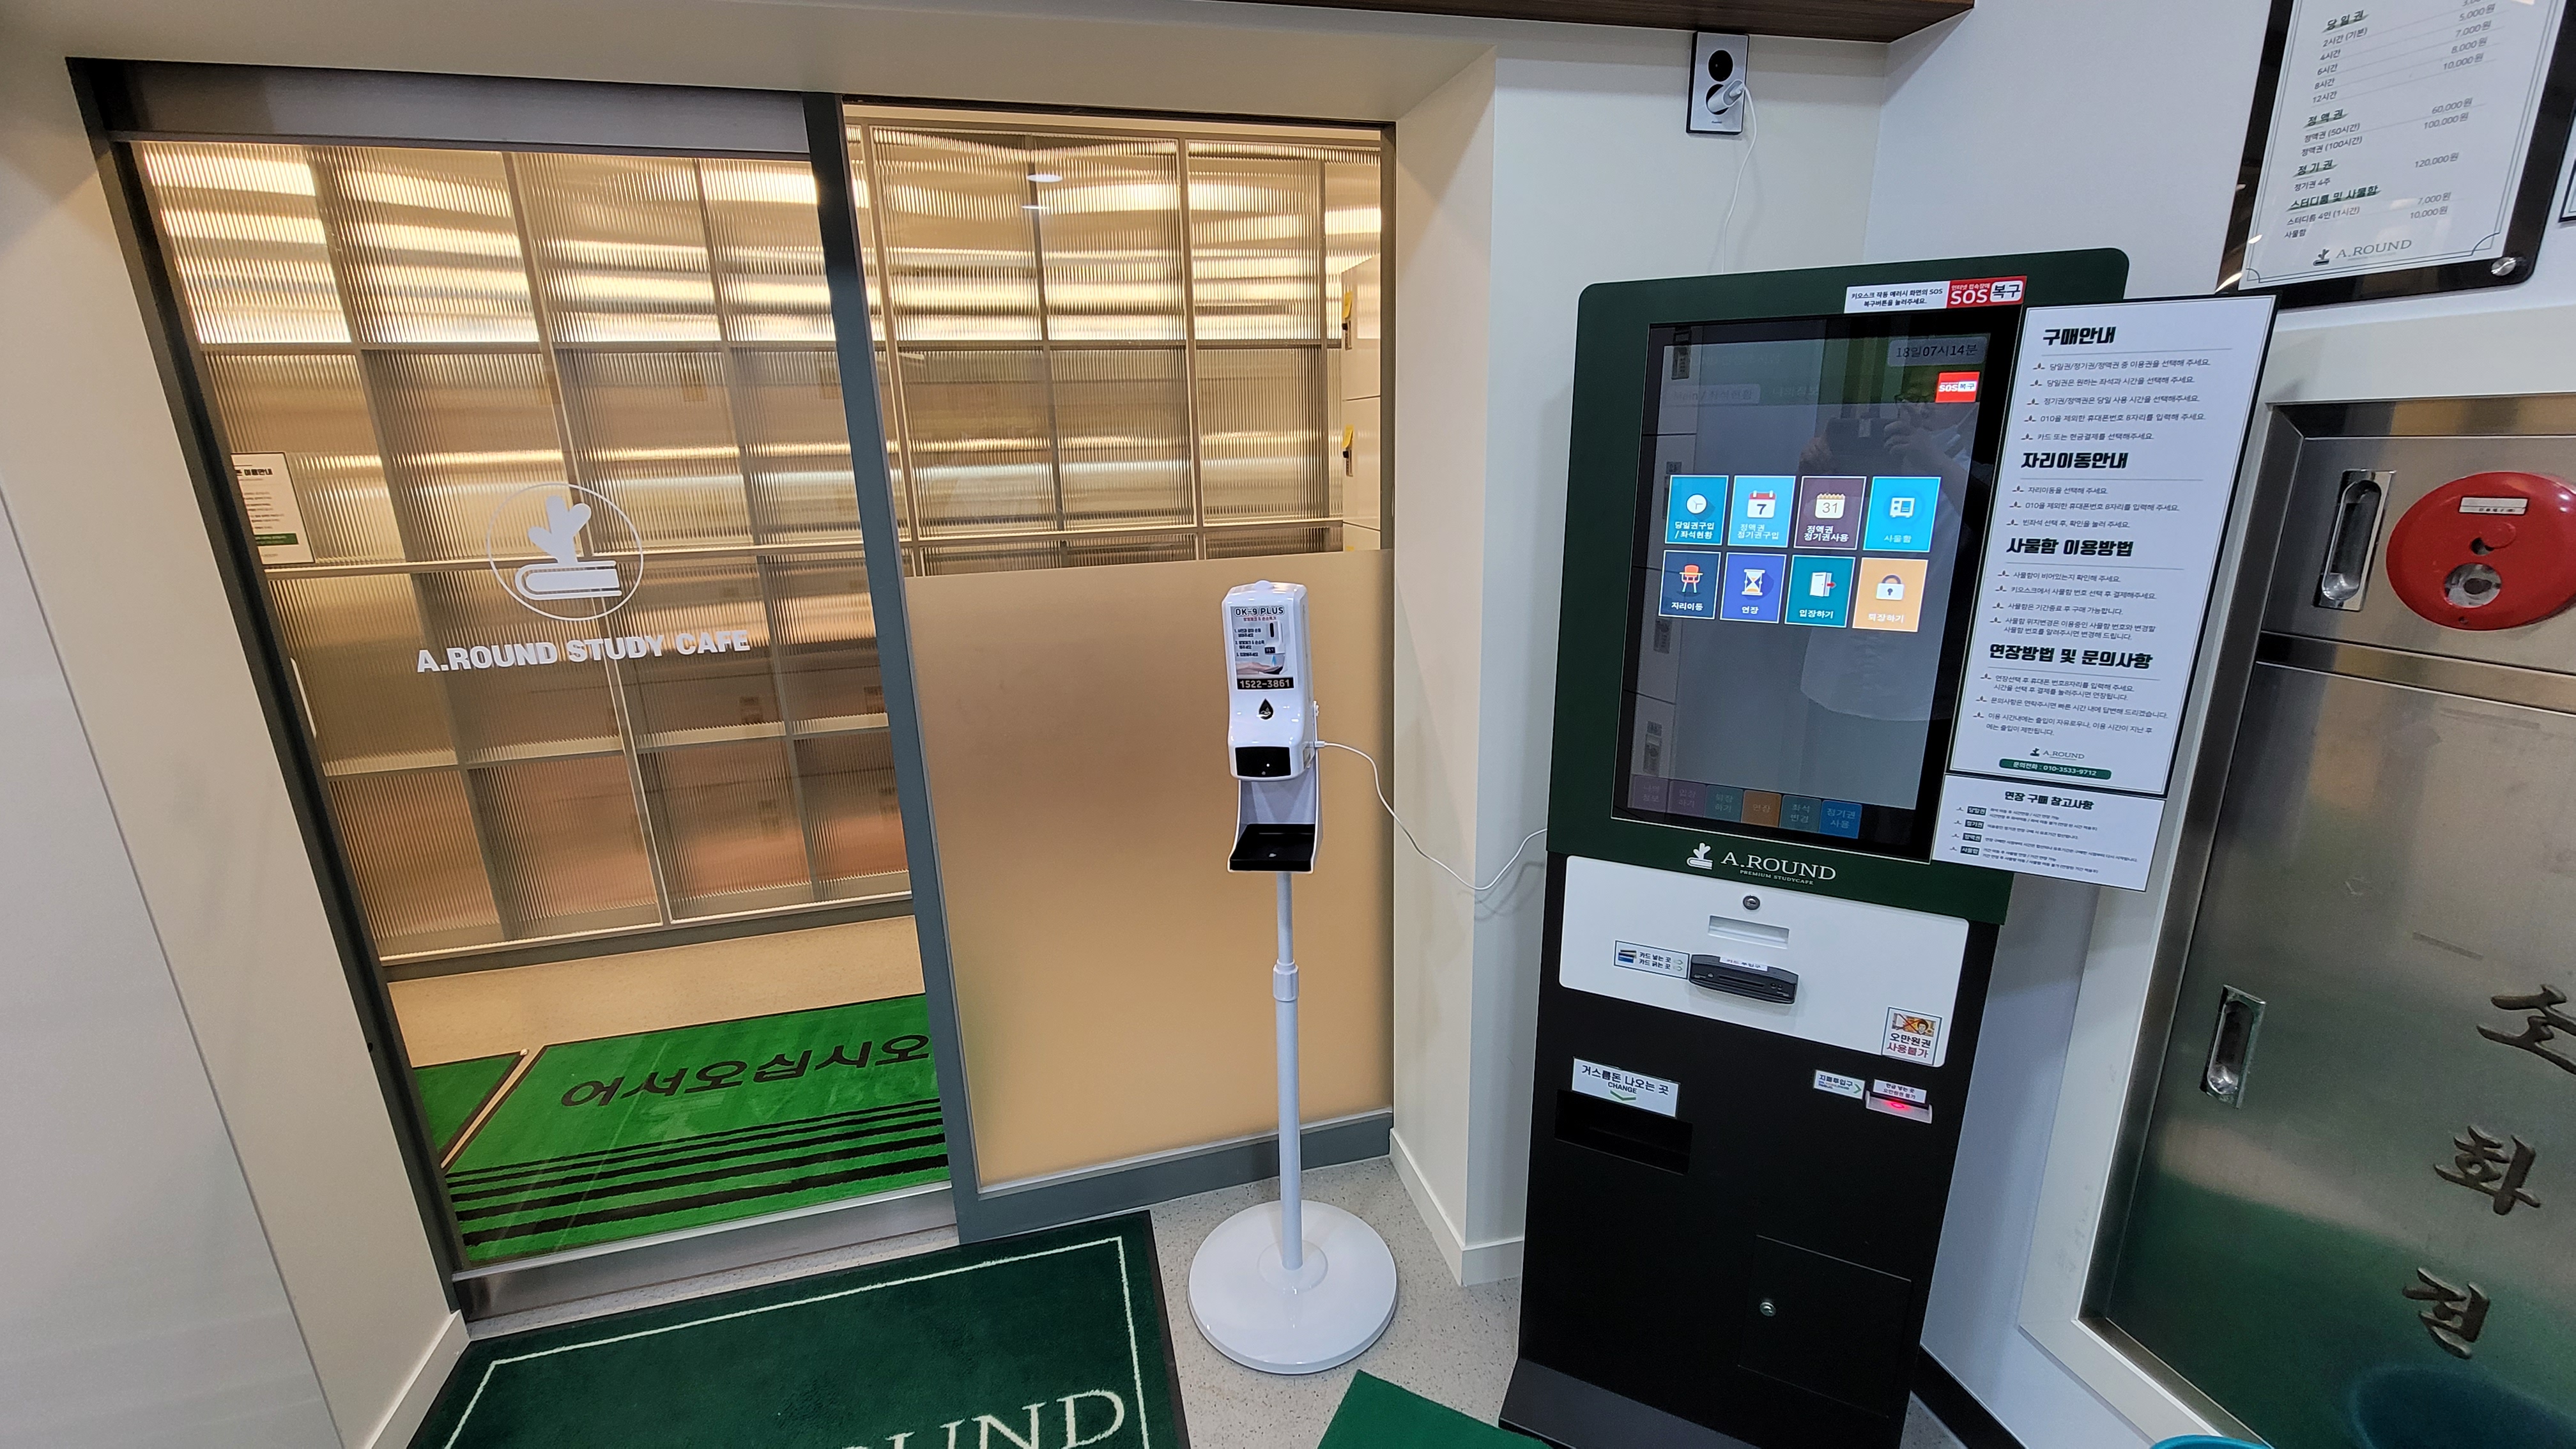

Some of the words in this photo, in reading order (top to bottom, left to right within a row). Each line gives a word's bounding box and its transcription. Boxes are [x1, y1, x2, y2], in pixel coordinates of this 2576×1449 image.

[2322, 34, 2343, 47] 2시간
[2345, 27, 2368, 41] (기본)
[2320, 49, 2341, 60] 4시간
[2444, 53, 2484, 70] 10,000원
[2317, 63, 2338, 75] 6시간
[2314, 78, 2335, 89] 8시간
[2313, 91, 2337, 103] 12시간
[2432, 97, 2472, 114] 60,000원
[2424, 112, 2469, 129] 100,000원
[2304, 130, 2326, 143] 정액권
[2328, 123, 2360, 137] (50시간)
[2325, 136, 2363, 151] (100시간)
[2414, 152, 2460, 168] 120,000원
[2294, 180, 2316, 192] 정기권
[2333, 192, 2343, 202] 및
[2346, 185, 2379, 199] 사물함
[2418, 192, 2451, 205] 7,000원
[2318, 211, 2331, 220] 4인
[2333, 206, 2360, 218] (1시간)
[2411, 206, 2448, 218] 10,000원
[2284, 229, 2306, 239] 사물함
[2336, 240, 2412, 259] A.ROUND
[1951, 289, 1988, 305] SOS
[1992, 284, 2021, 298] 복구
[2043, 326, 2117, 346] 구매안내
[2162, 359, 2184, 367] 선택해
[1938, 383, 1959, 392] SOS
[2047, 379, 2074, 387] 당일권은
[2123, 377, 2144, 385] 시간을
[2021, 452, 2129, 469] 자리이동안내
[1756, 503, 1767, 516] 7
[1822, 502, 1839, 514] 31
[1675, 521, 1715, 531] 당일권구입
[1740, 523, 1765, 532] 정액권
[1807, 525, 1834, 534] 정액권
[1737, 530, 1779, 540] 정기권구입
[1804, 532, 1849, 542] 정기권사용
[1884, 534, 1912, 543] 사물함
[2006, 538, 2059, 555] 사물함
[2063, 539, 2134, 556] 이용방법
[1235, 608, 1258, 616] OK-9
[1261, 606, 1284, 615] PLUS
[1671, 602, 1703, 611] 자리이동
[1741, 605, 1759, 615] 연장
[1799, 609, 1834, 619] 입장하기
[1867, 613, 1905, 624] 퇴장하기
[417, 641, 558, 673] A.ROUND
[567, 635, 664, 663] STUDY
[675, 629, 750, 656] CAFE
[1989, 643, 2055, 663] 연장방법
[2060, 648, 2077, 664] 및
[2082, 650, 2154, 670] 문의사항
[1240, 679, 1290, 688] 1522-3861
[2043, 750, 2085, 759] A.ROUND
[2043, 765, 2097, 776] 010-3533-9712
[2005, 791, 2025, 802] 연장
[2051, 796, 2094, 810] 참고사항
[1752, 803, 1772, 813] 연장
[1826, 808, 1856, 820] 정기권
[1830, 818, 1851, 829] 사용
[1721, 852, 1836, 880] A.ROUND
[1740, 870, 1772, 878] PREMIUM
[1773, 875, 1814, 885] STUDYCAFE
[1889, 1032, 1931, 1048] 오만원권
[1887, 1042, 1928, 1058] 사용불가
[561, 1034, 930, 1107] 어서오십시오
[1582, 1064, 1621, 1082] 거스름돈
[1625, 1076, 1655, 1092] 나오는
[1659, 1084, 1669, 1095] 곳
[1819, 1074, 1853, 1087] 지폐투입구
[1607, 1082, 1637, 1094] CHANGE
